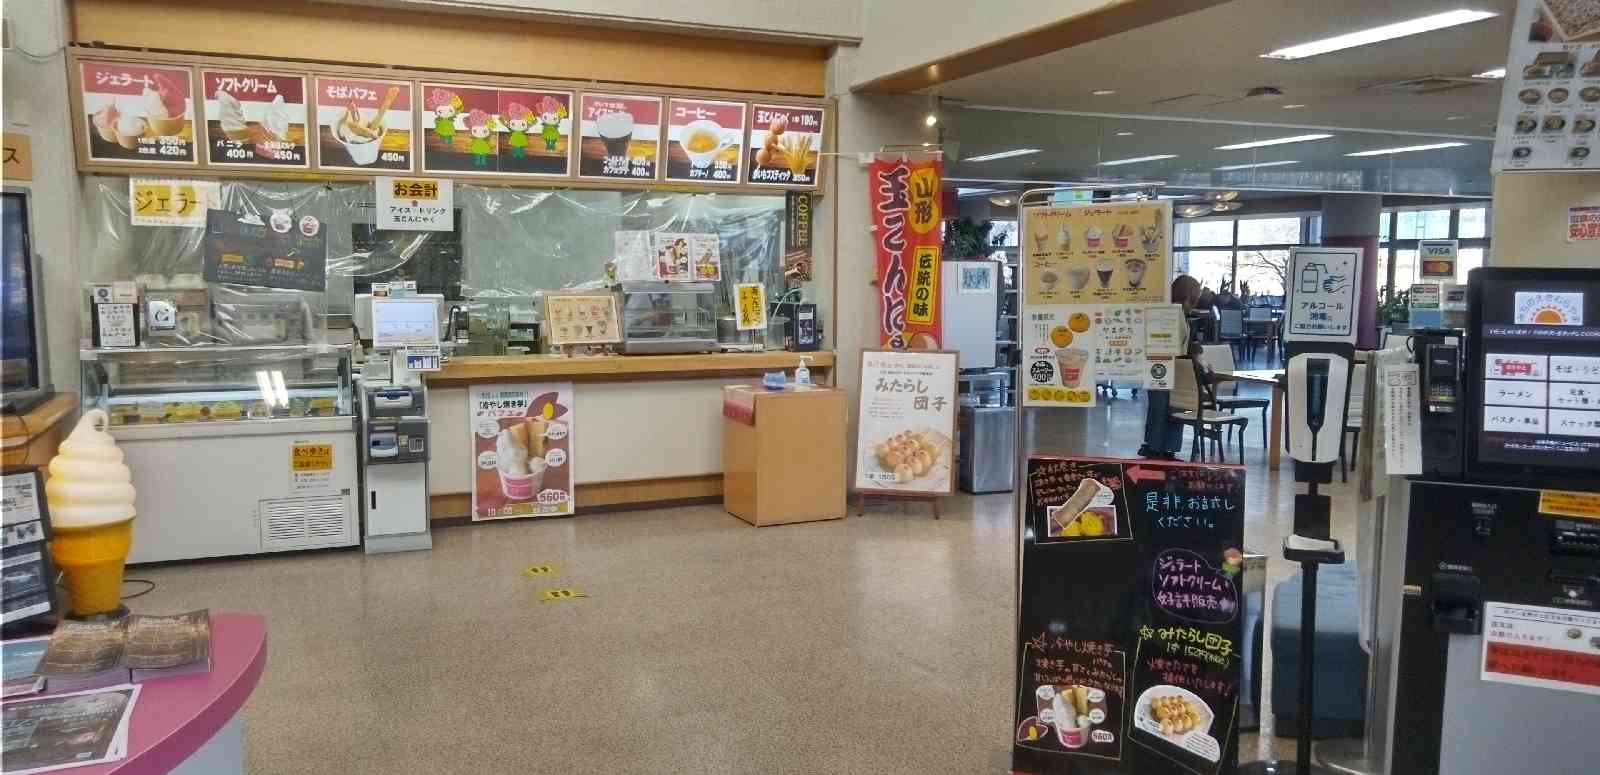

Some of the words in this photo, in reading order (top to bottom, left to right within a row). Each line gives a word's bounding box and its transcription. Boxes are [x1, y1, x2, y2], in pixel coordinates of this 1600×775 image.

[95, 71, 154, 87] ジェラート
[216, 77, 277, 94] ソフトクリーム
[674, 106, 717, 120] コーヒー
[394, 182, 438, 199] お会計
[135, 189, 212, 214] ジェラー
[916, 178, 933, 225] 山形
[798, 193, 809, 248] COFFEE
[1426, 247, 1451, 255] VISA
[913, 254, 934, 318] 伝統の味
[1301, 301, 1345, 312] アルコール
[875, 378, 929, 394] みたらし
[914, 395, 948, 412] 団子
[1145, 490, 1181, 513] 是非
[1158, 514, 1216, 528] ください。
[1159, 556, 1201, 573] ジェラート
[1158, 574, 1222, 591] ソフトクリーム
[1157, 627, 1233, 656] みたらし団子
